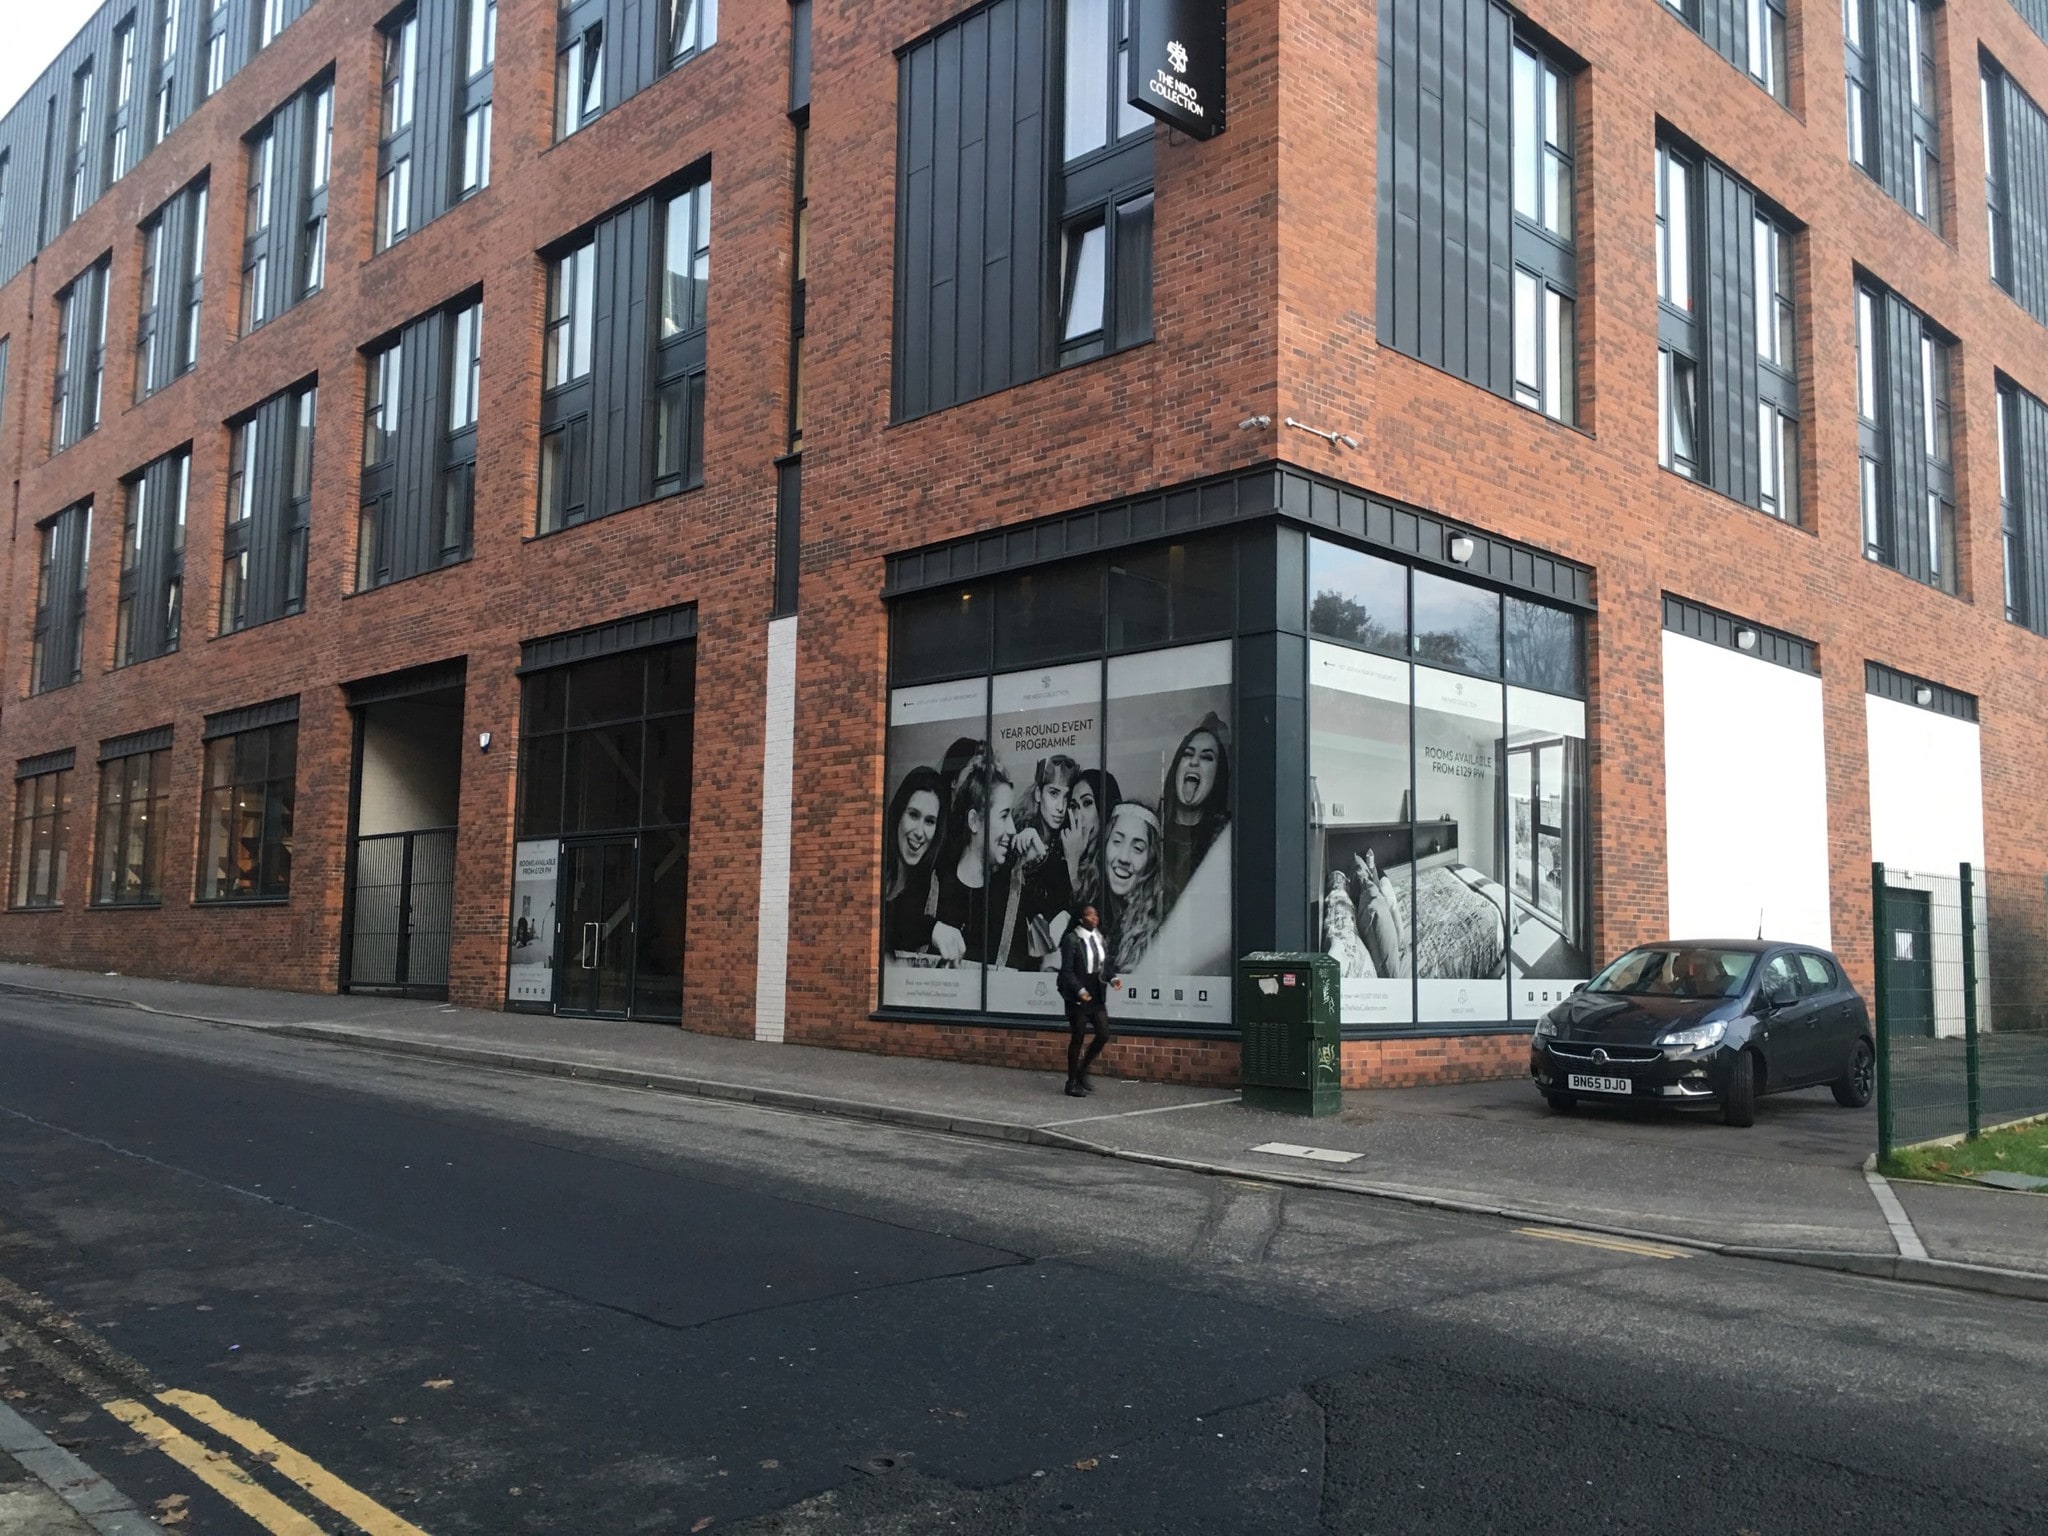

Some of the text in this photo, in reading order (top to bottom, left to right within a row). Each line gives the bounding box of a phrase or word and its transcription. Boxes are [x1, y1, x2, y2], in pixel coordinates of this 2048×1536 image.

[1157, 69, 1197, 100] THE NIDO
[1149, 79, 1204, 117] COLLECTION
[1000, 719, 1093, 739] YEAR-ROUND EVENT
[1015, 734, 1076, 751] PROGRAMME
[1425, 746, 1492, 768] ROOMS AVAILABLE
[1432, 761, 1455, 775] FROM
[1473, 768, 1485, 779] PW
[1573, 1075, 1626, 1091] BN65 DJO
